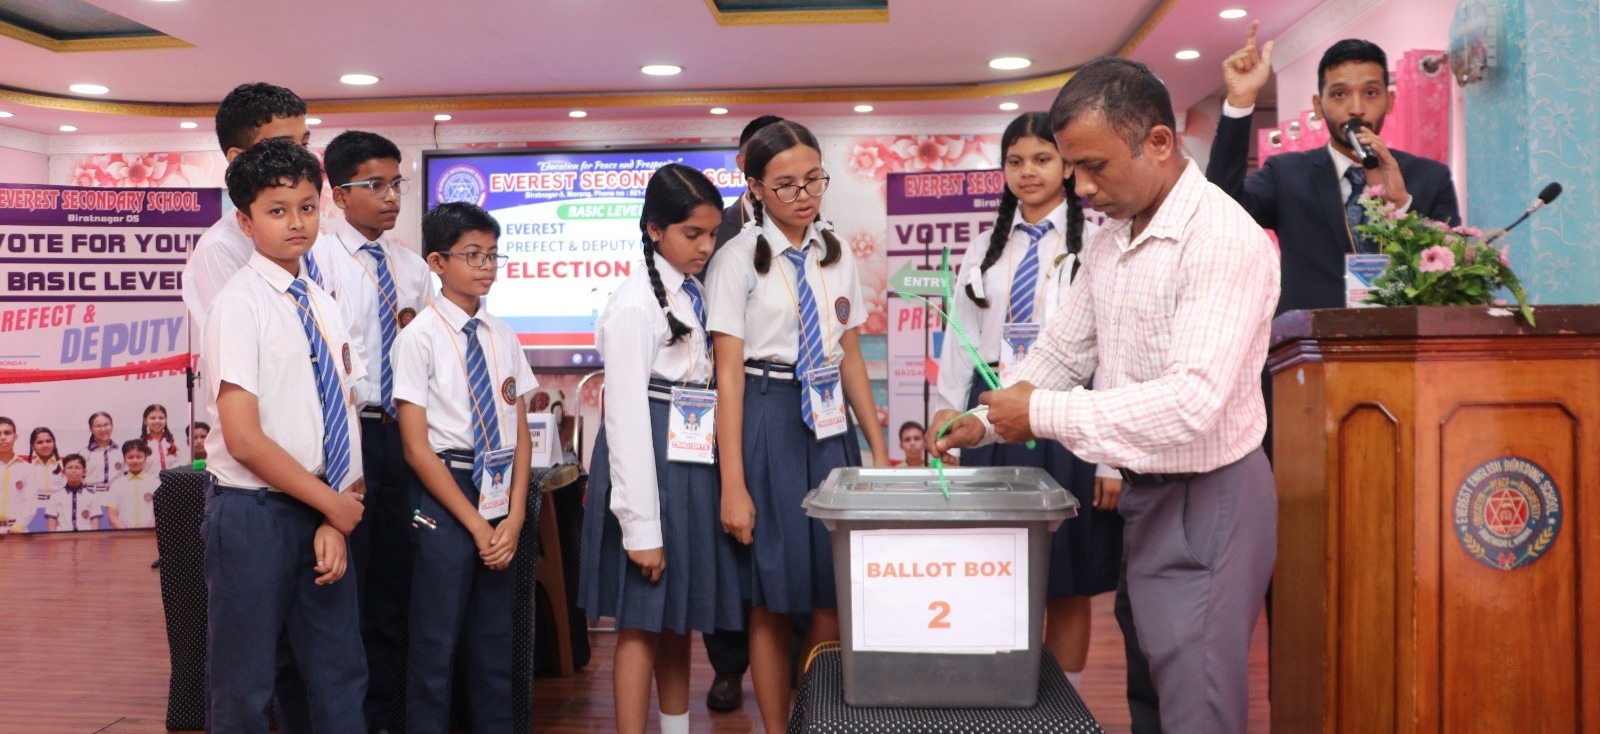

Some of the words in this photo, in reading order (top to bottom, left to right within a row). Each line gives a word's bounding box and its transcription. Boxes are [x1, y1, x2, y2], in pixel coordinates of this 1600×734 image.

[581, 160, 593, 172] for
[595, 160, 617, 169] Peace
[619, 159, 635, 169] and
[490, 172, 577, 192] EVEREST
[703, 167, 748, 188] SCH
[904, 174, 965, 199] EVEREST
[967, 171, 1006, 195] SECO
[0, 188, 60, 212] EVEREST
[61, 189, 146, 214] SECONDARY
[147, 190, 201, 214] SCHOOL
[594, 188, 617, 196] Phone
[567, 205, 605, 217] BASIC
[973, 198, 1003, 208] Birat
[67, 214, 124, 225] Biratnagar
[506, 223, 566, 236] EVEREST
[895, 222, 970, 245] VOTE
[71, 234, 126, 253] FOR
[506, 241, 564, 252] PREFECT
[569, 241, 578, 251] &
[582, 240, 635, 251] DEPUTY
[507, 260, 631, 279] ELECTION
[7, 271, 97, 291] BASIC
[903, 276, 949, 288] ENTRY
[0, 304, 76, 332] REFECT
[83, 304, 96, 324] &
[61, 316, 184, 368] DEPUTY
[672, 442, 710, 450] CANDIDATE
[1456, 484, 1473, 524] EVEREST
[1467, 461, 1501, 487] ENGLISH
[1504, 458, 1544, 483] BOARDING
[867, 562, 956, 578] BALLOT
[964, 561, 1012, 577] BOX
[927, 600, 952, 629] 2
